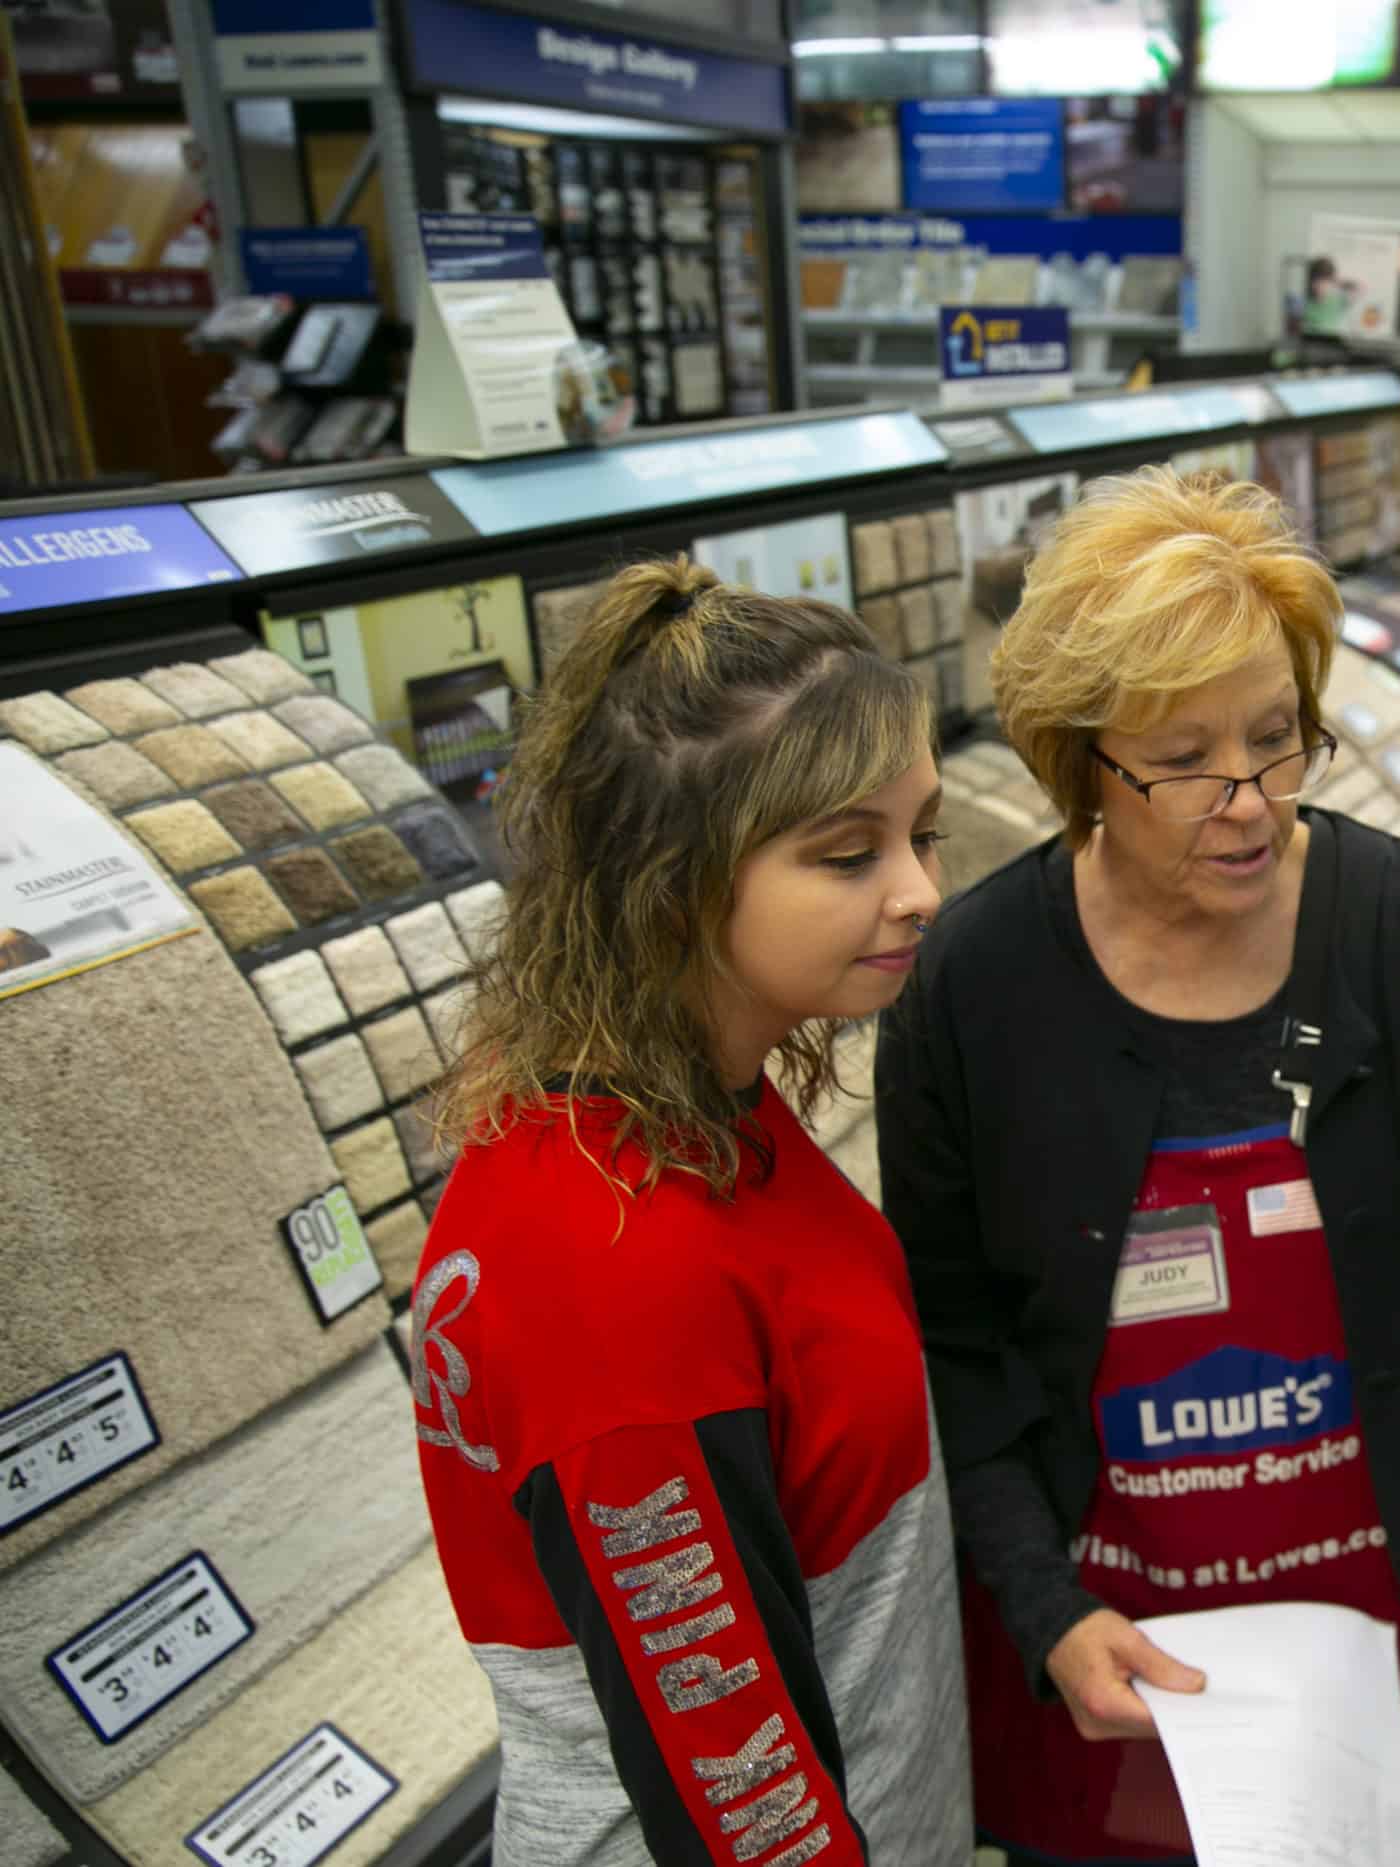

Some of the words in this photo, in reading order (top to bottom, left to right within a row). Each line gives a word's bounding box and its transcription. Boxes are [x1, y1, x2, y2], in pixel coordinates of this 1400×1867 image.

[15, 856, 122, 897] STAINMASTER
[1137, 1264, 1190, 1287] JUDY
[1138, 1377, 1325, 1448] LOWE'S
[1108, 1460, 1250, 1498] Customer
[1254, 1435, 1361, 1485] Service
[586, 1476, 760, 1713] PINK
[1146, 1563, 1187, 1590] us
[1192, 1559, 1229, 1588] at
[690, 1712, 831, 1867] INK
